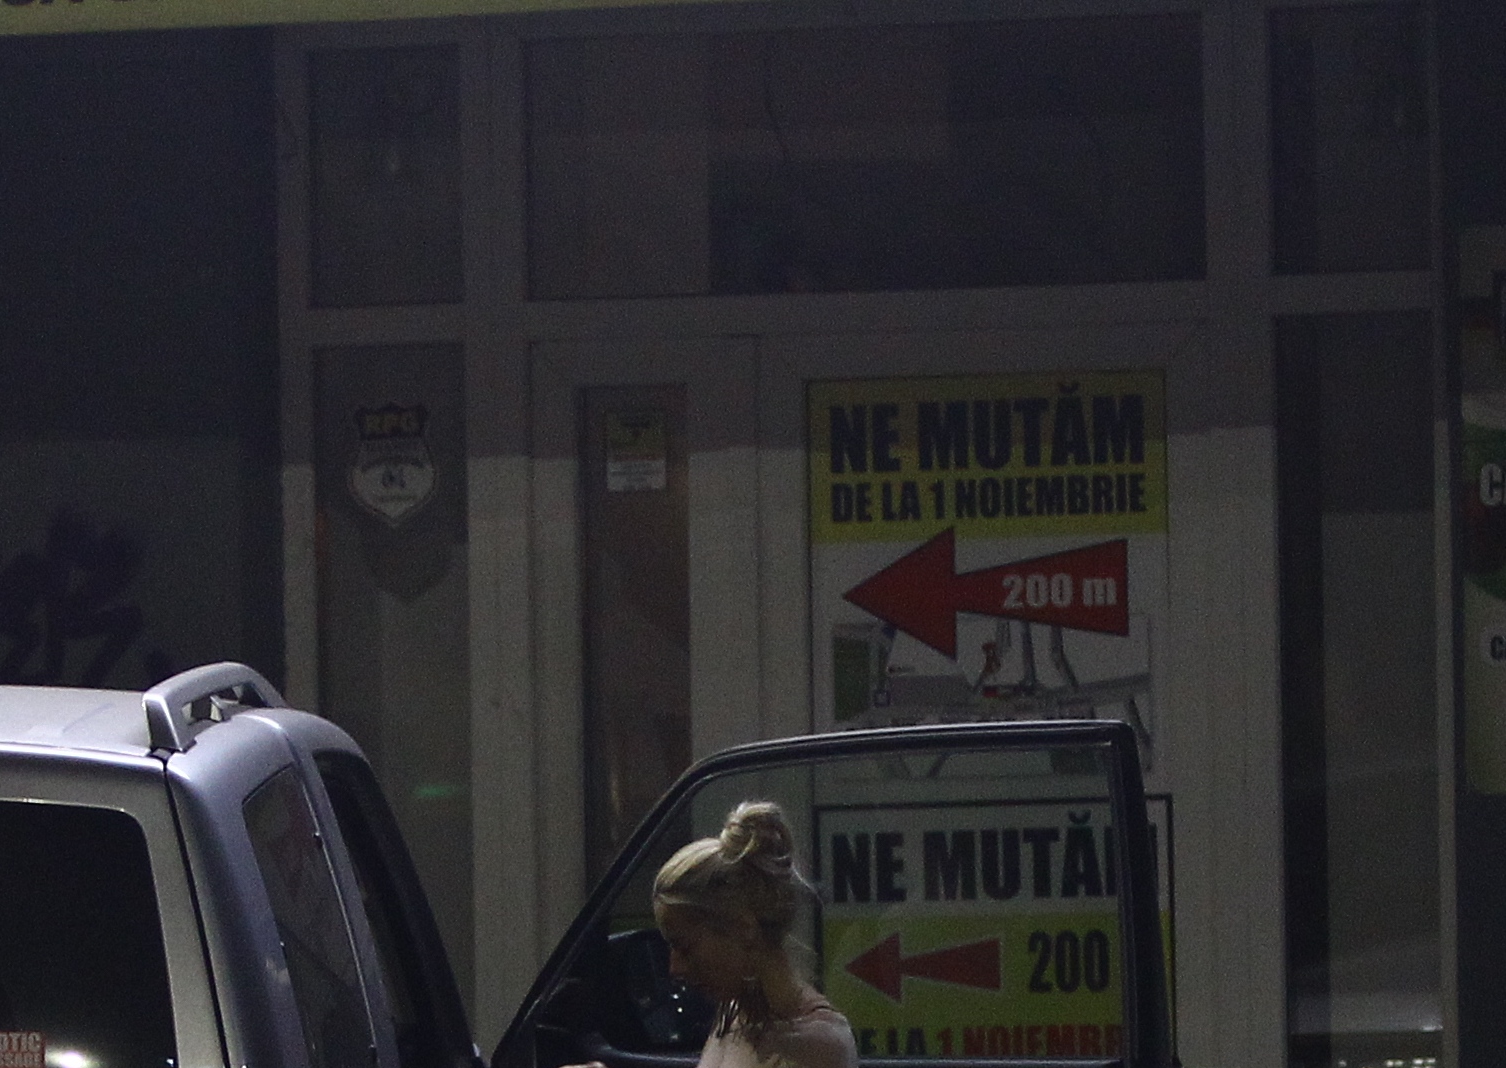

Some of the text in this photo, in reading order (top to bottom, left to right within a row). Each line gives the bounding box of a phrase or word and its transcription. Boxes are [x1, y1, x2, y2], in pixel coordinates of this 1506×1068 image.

[830, 382, 1144, 473] NE MUTĂM
[832, 473, 1147, 523] DE LA 1 NOIEMBRIE
[1001, 572, 1118, 609] 200 m
[832, 832, 907, 902] NE
[1027, 928, 1110, 993] 200
[936, 1026, 953, 1056] 1
